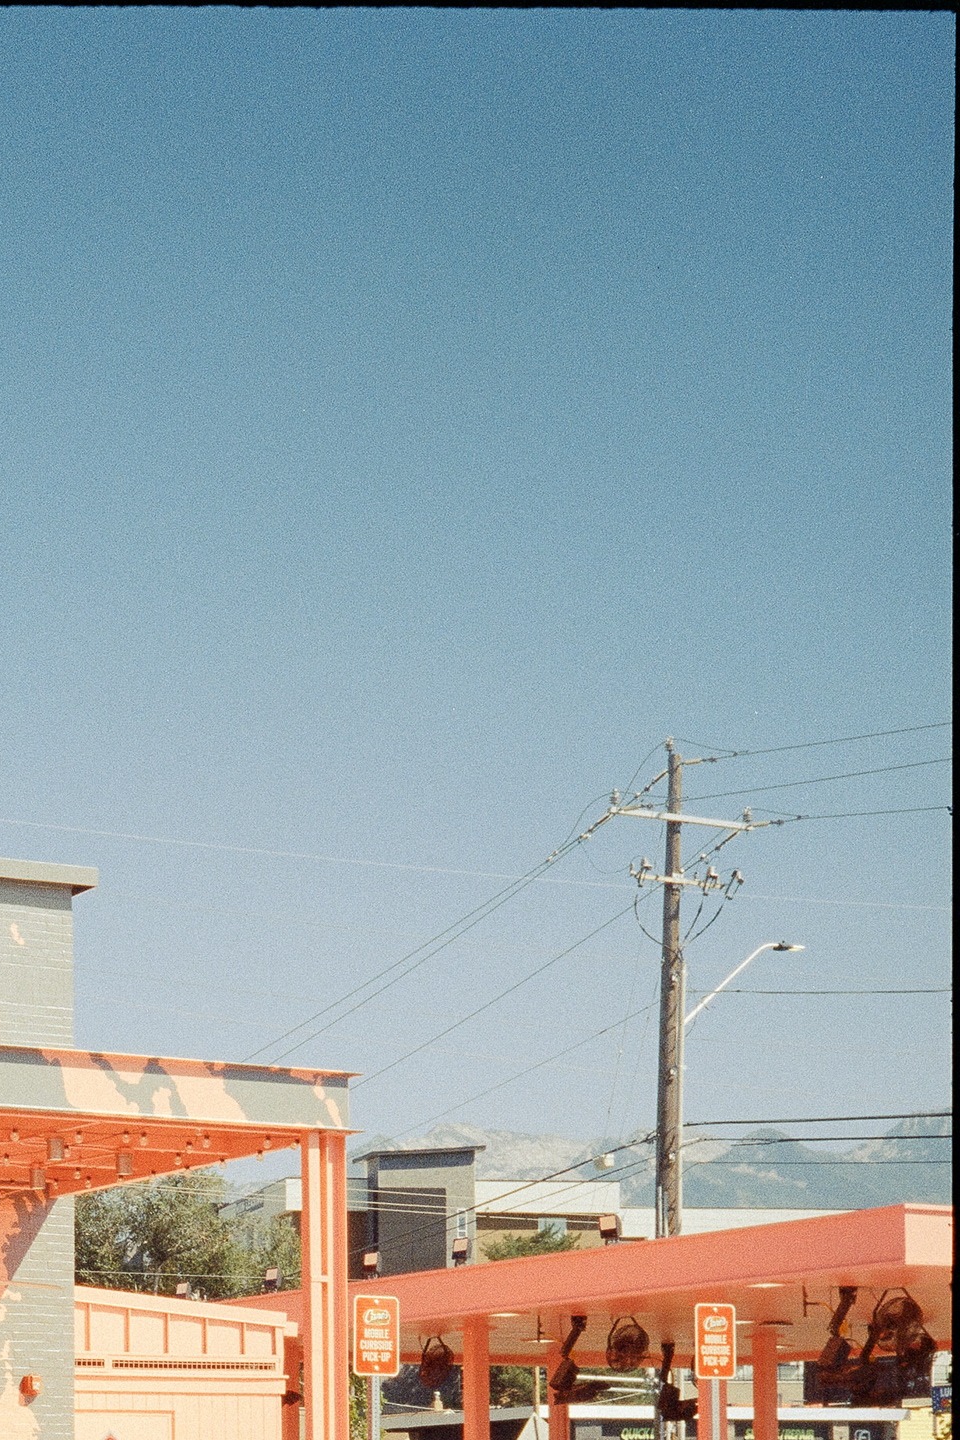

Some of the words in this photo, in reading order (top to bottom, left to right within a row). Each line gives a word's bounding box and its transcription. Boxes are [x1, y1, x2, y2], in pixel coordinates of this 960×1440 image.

[364, 1328, 390, 1339] MOBILE
[704, 1334, 727, 1344] MOBILE
[360, 1340, 393, 1350] CURBSIDE
[362, 1351, 391, 1362] PICK-UP
[703, 1356, 729, 1366] PICK-UP
[620, 1427, 651, 1440] QUICK
